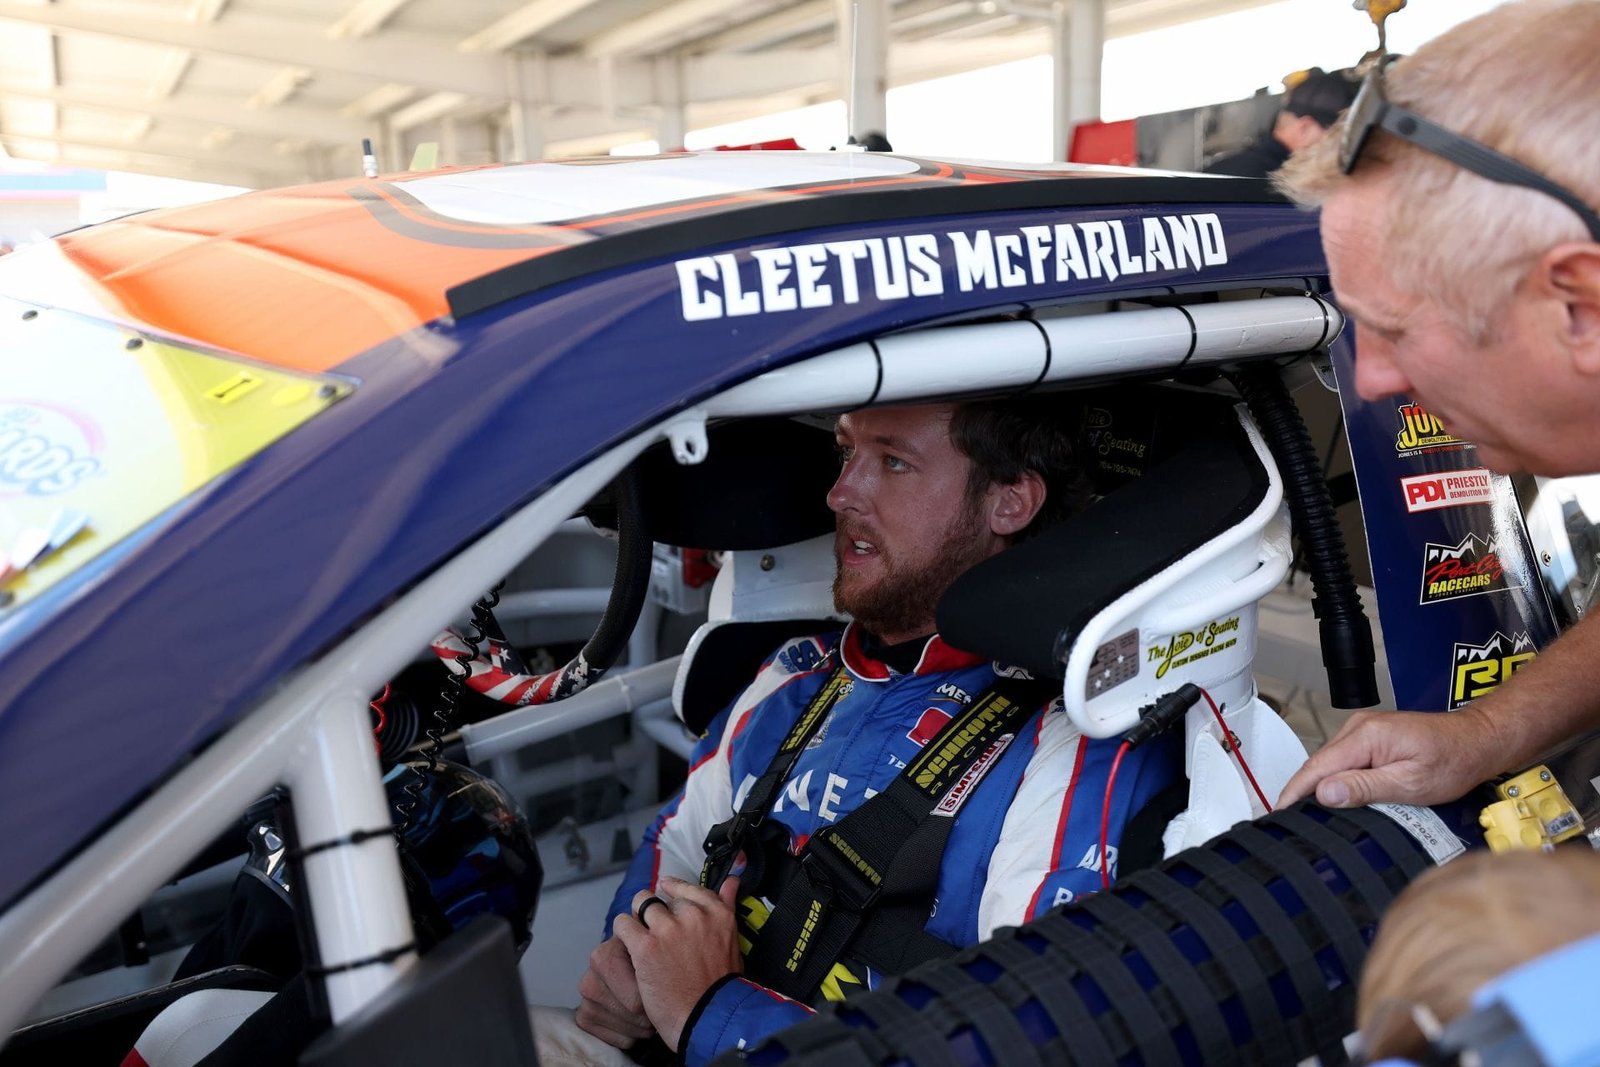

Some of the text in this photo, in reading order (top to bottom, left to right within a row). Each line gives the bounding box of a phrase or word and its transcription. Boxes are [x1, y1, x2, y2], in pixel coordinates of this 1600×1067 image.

[674, 233, 943, 322] CLEETUS
[1098, 431, 1146, 458] Seating
[1406, 479, 1446, 505] PDI
[1447, 475, 1489, 490] PRIESTLY
[1450, 488, 1482, 499] DEMOLITION
[1429, 574, 1491, 595] RACECARS
[1147, 645, 1167, 663] The
[1196, 626, 1208, 644] of
[1205, 616, 1240, 647] Seating
[915, 695, 1012, 789] SCHROTH
[943, 744, 998, 810] SIMPSON
[1386, 803, 1413, 822] JUN
[1412, 821, 1438, 847] 2026
[828, 832, 882, 886] SCHROTH
